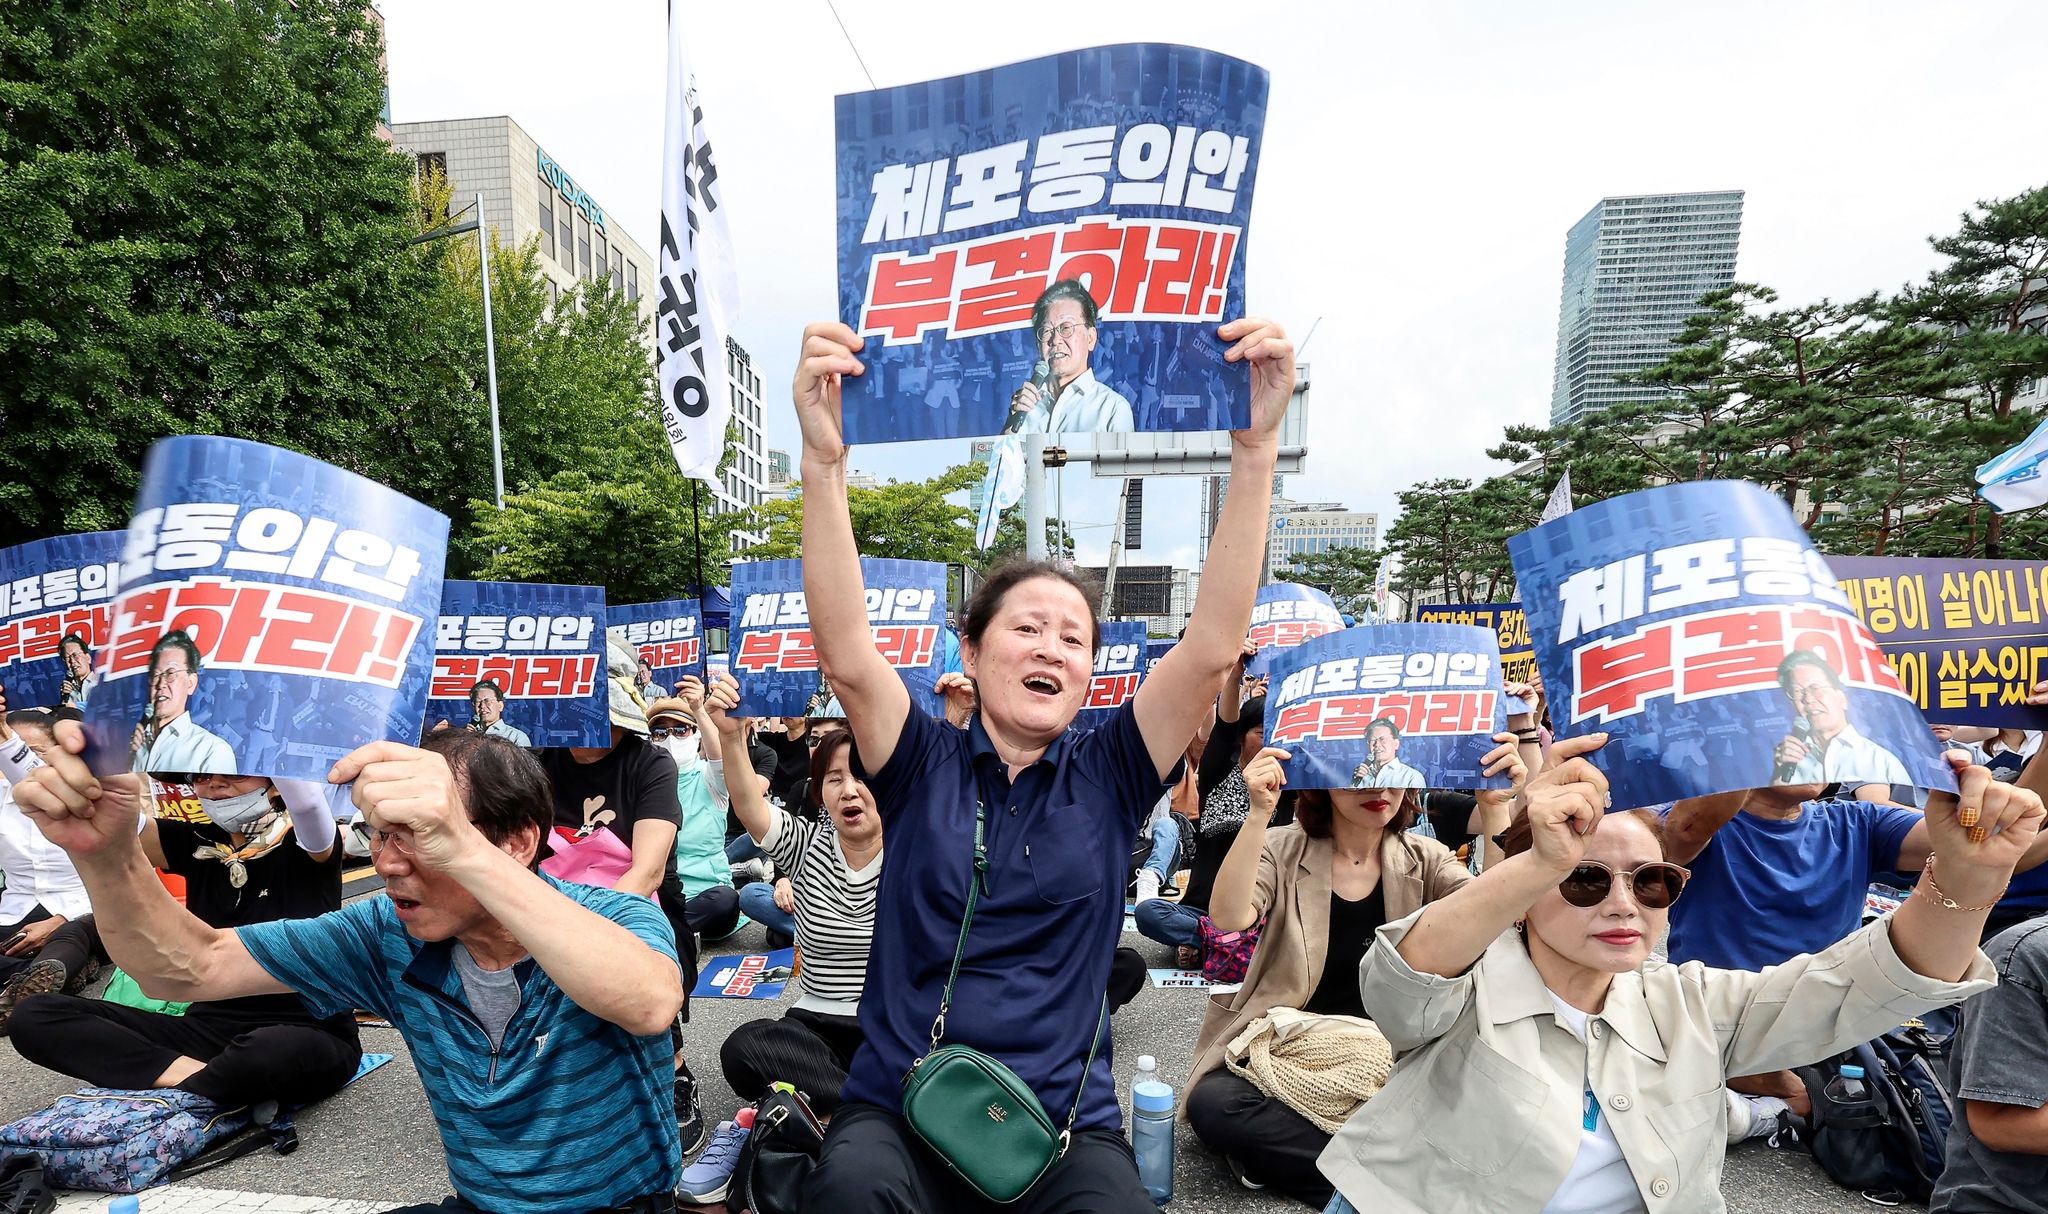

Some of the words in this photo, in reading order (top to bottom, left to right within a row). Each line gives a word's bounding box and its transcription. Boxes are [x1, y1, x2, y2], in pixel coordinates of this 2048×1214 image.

[861, 122, 1249, 244] 체포동의안
[863, 222, 1236, 340] 부결하라!
[739, 588, 937, 628] 체포의안
[1498, 608, 1533, 649] 정치
[738, 627, 936, 671] 부결라!
[1081, 674, 1138, 707] 라!
[1275, 652, 1491, 708] 체포동의안
[1883, 652, 1928, 710] 이
[1274, 692, 1495, 742] 부결하라!
